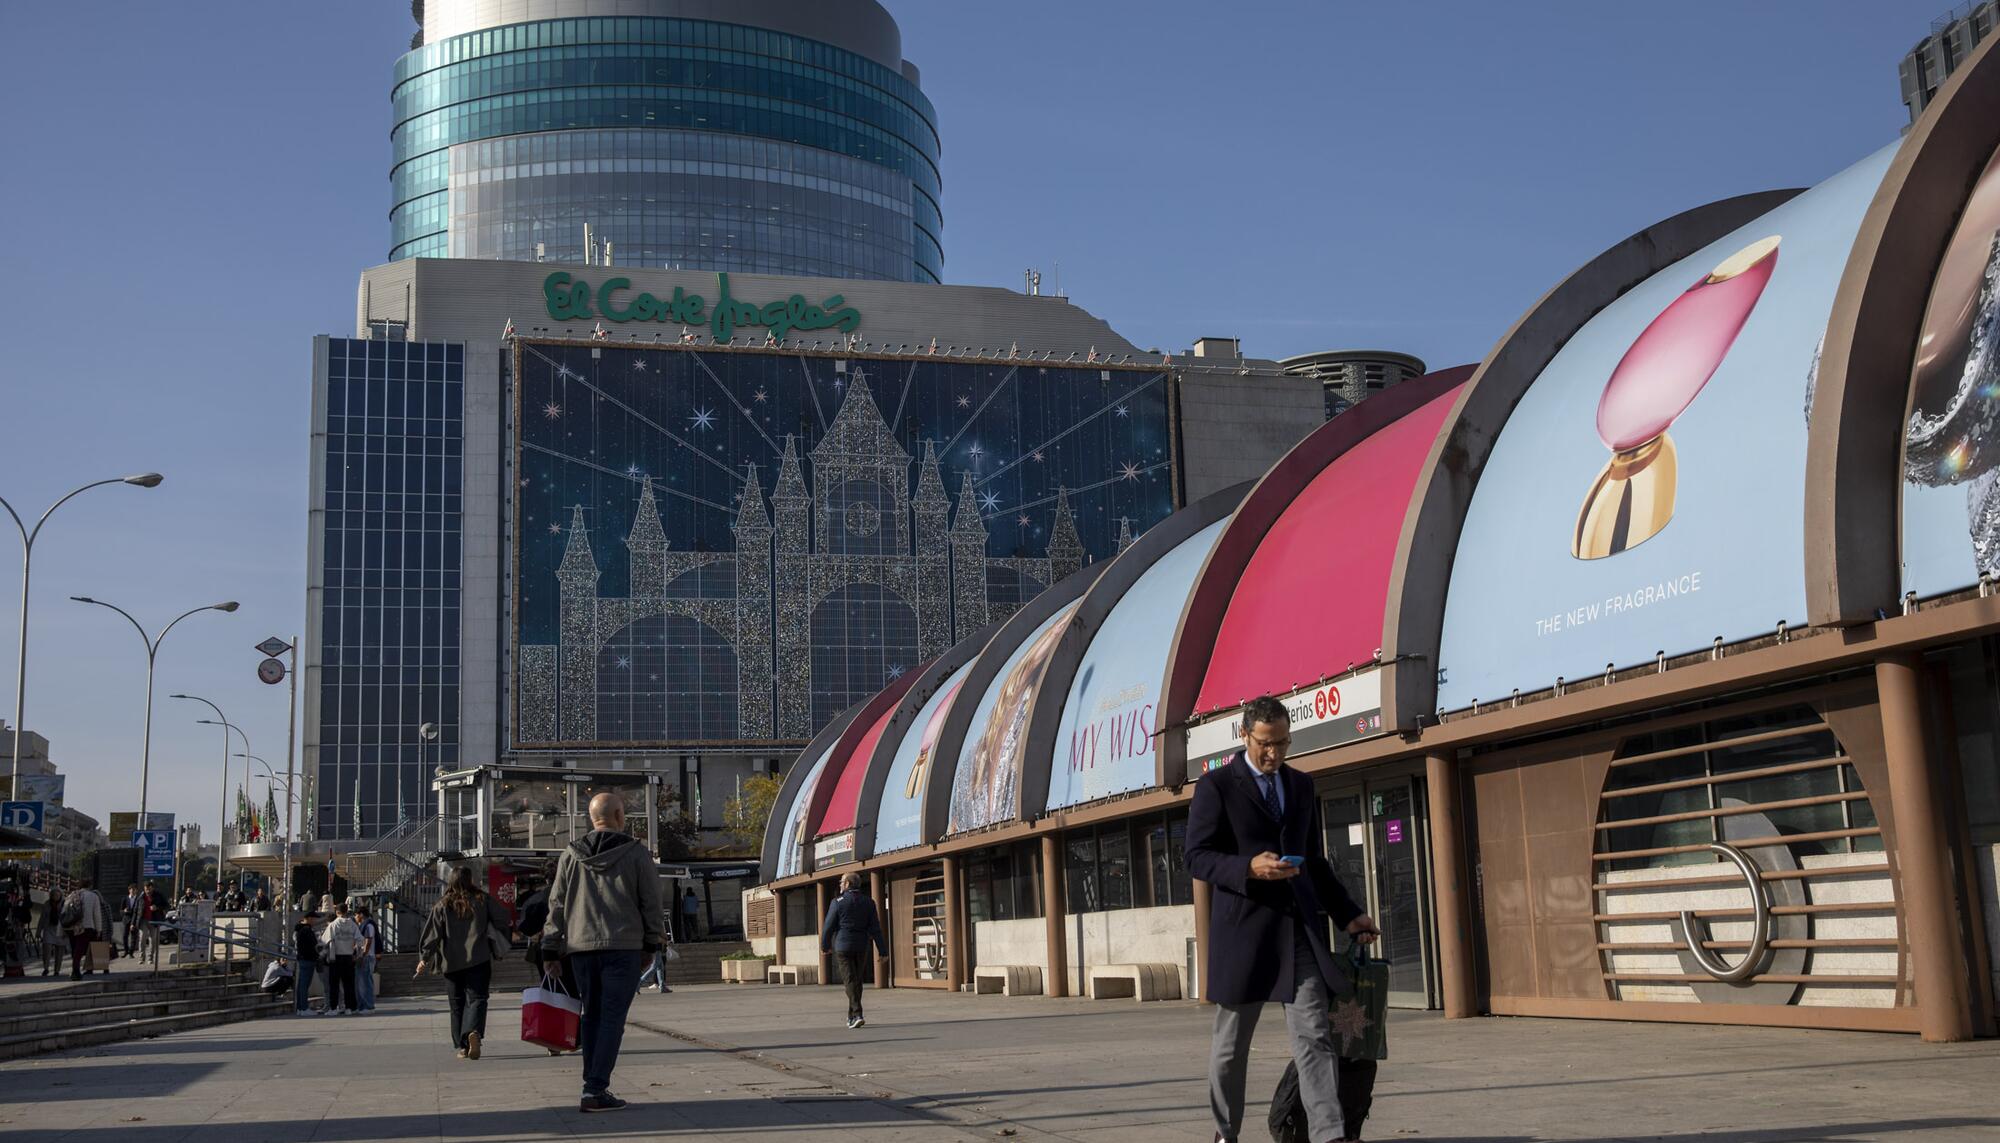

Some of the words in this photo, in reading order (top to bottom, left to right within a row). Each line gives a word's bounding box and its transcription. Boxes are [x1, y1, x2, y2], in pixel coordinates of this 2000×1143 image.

[543, 271, 593, 321] El
[599, 277, 706, 325] Corte
[1536, 614, 1562, 637] THE
[1567, 604, 1600, 630] NEW
[1605, 572, 1702, 617] FRAGRANCE
[1068, 720, 1104, 774] MY
[155, 834, 166, 849] P
